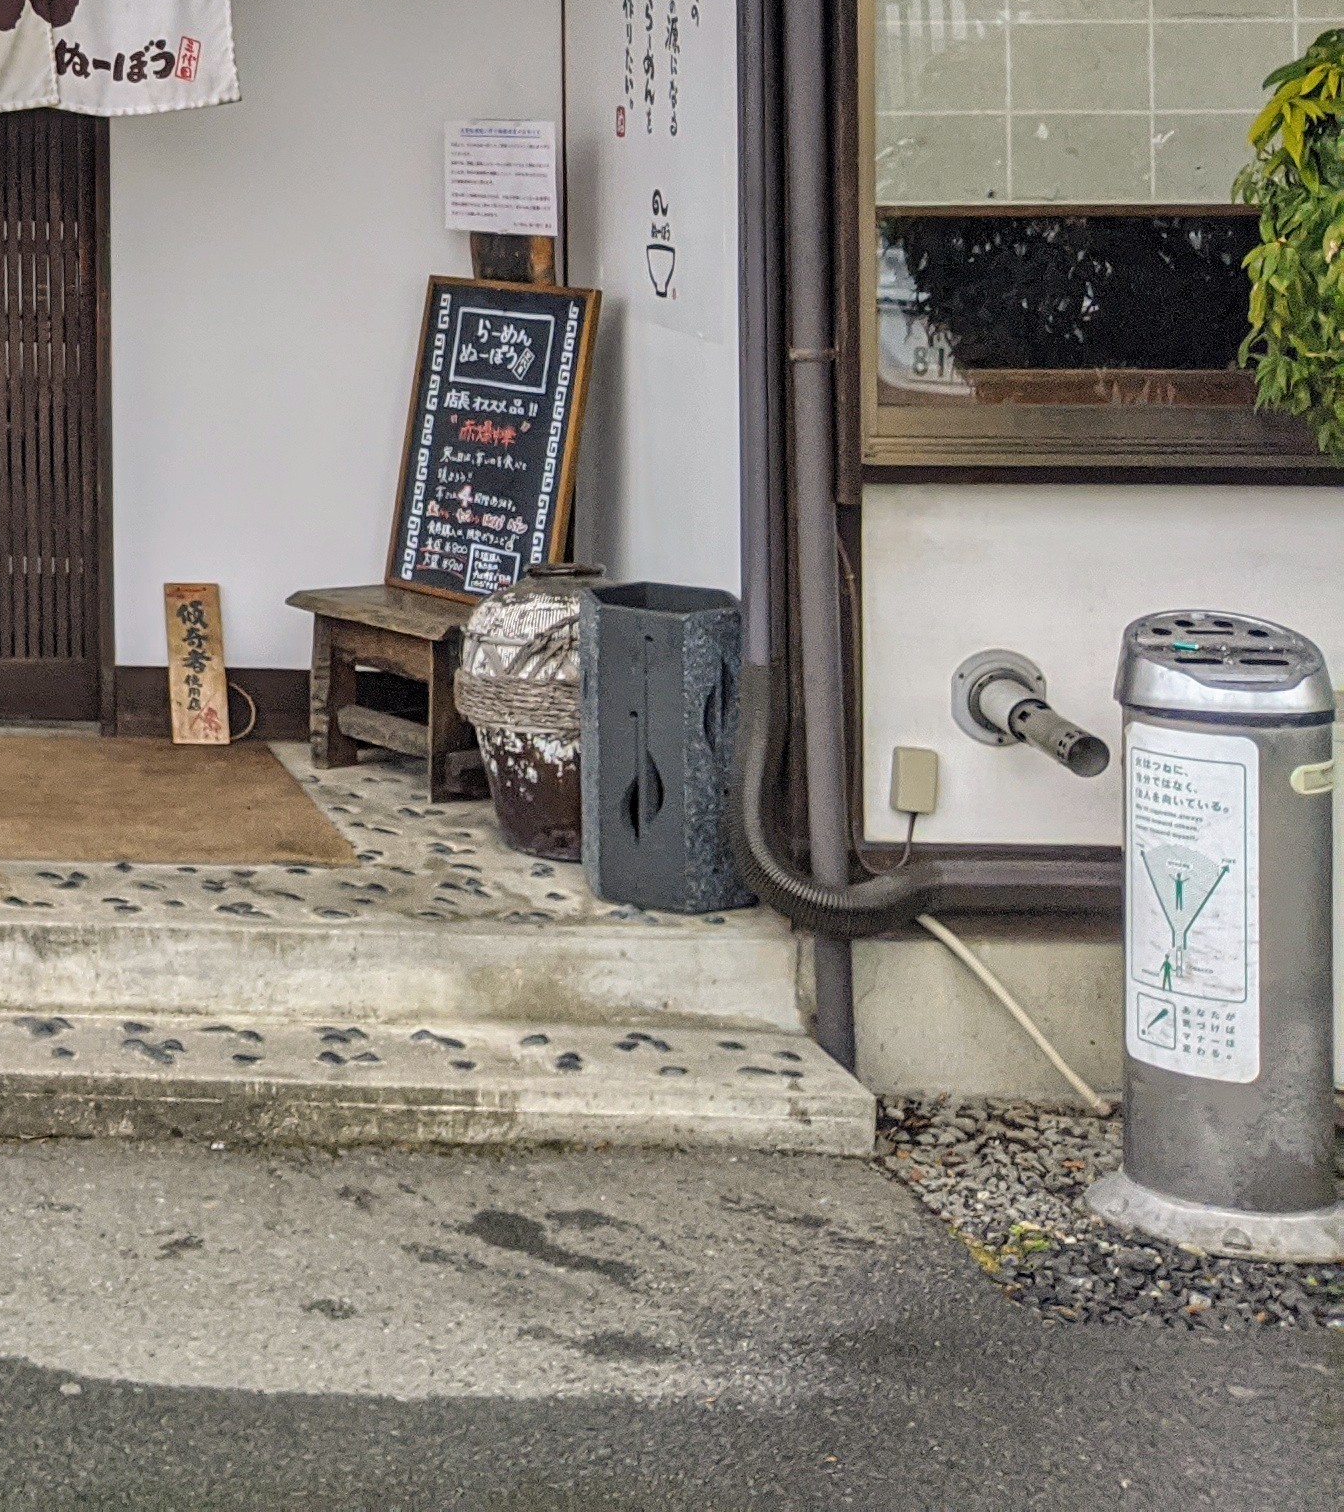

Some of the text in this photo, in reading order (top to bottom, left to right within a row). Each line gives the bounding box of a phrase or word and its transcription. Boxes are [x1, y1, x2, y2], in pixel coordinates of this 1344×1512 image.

[55, 38, 176, 84] ぬーぼう
[477, 318, 532, 347] らーめん
[459, 343, 518, 370] ぬーぼう
